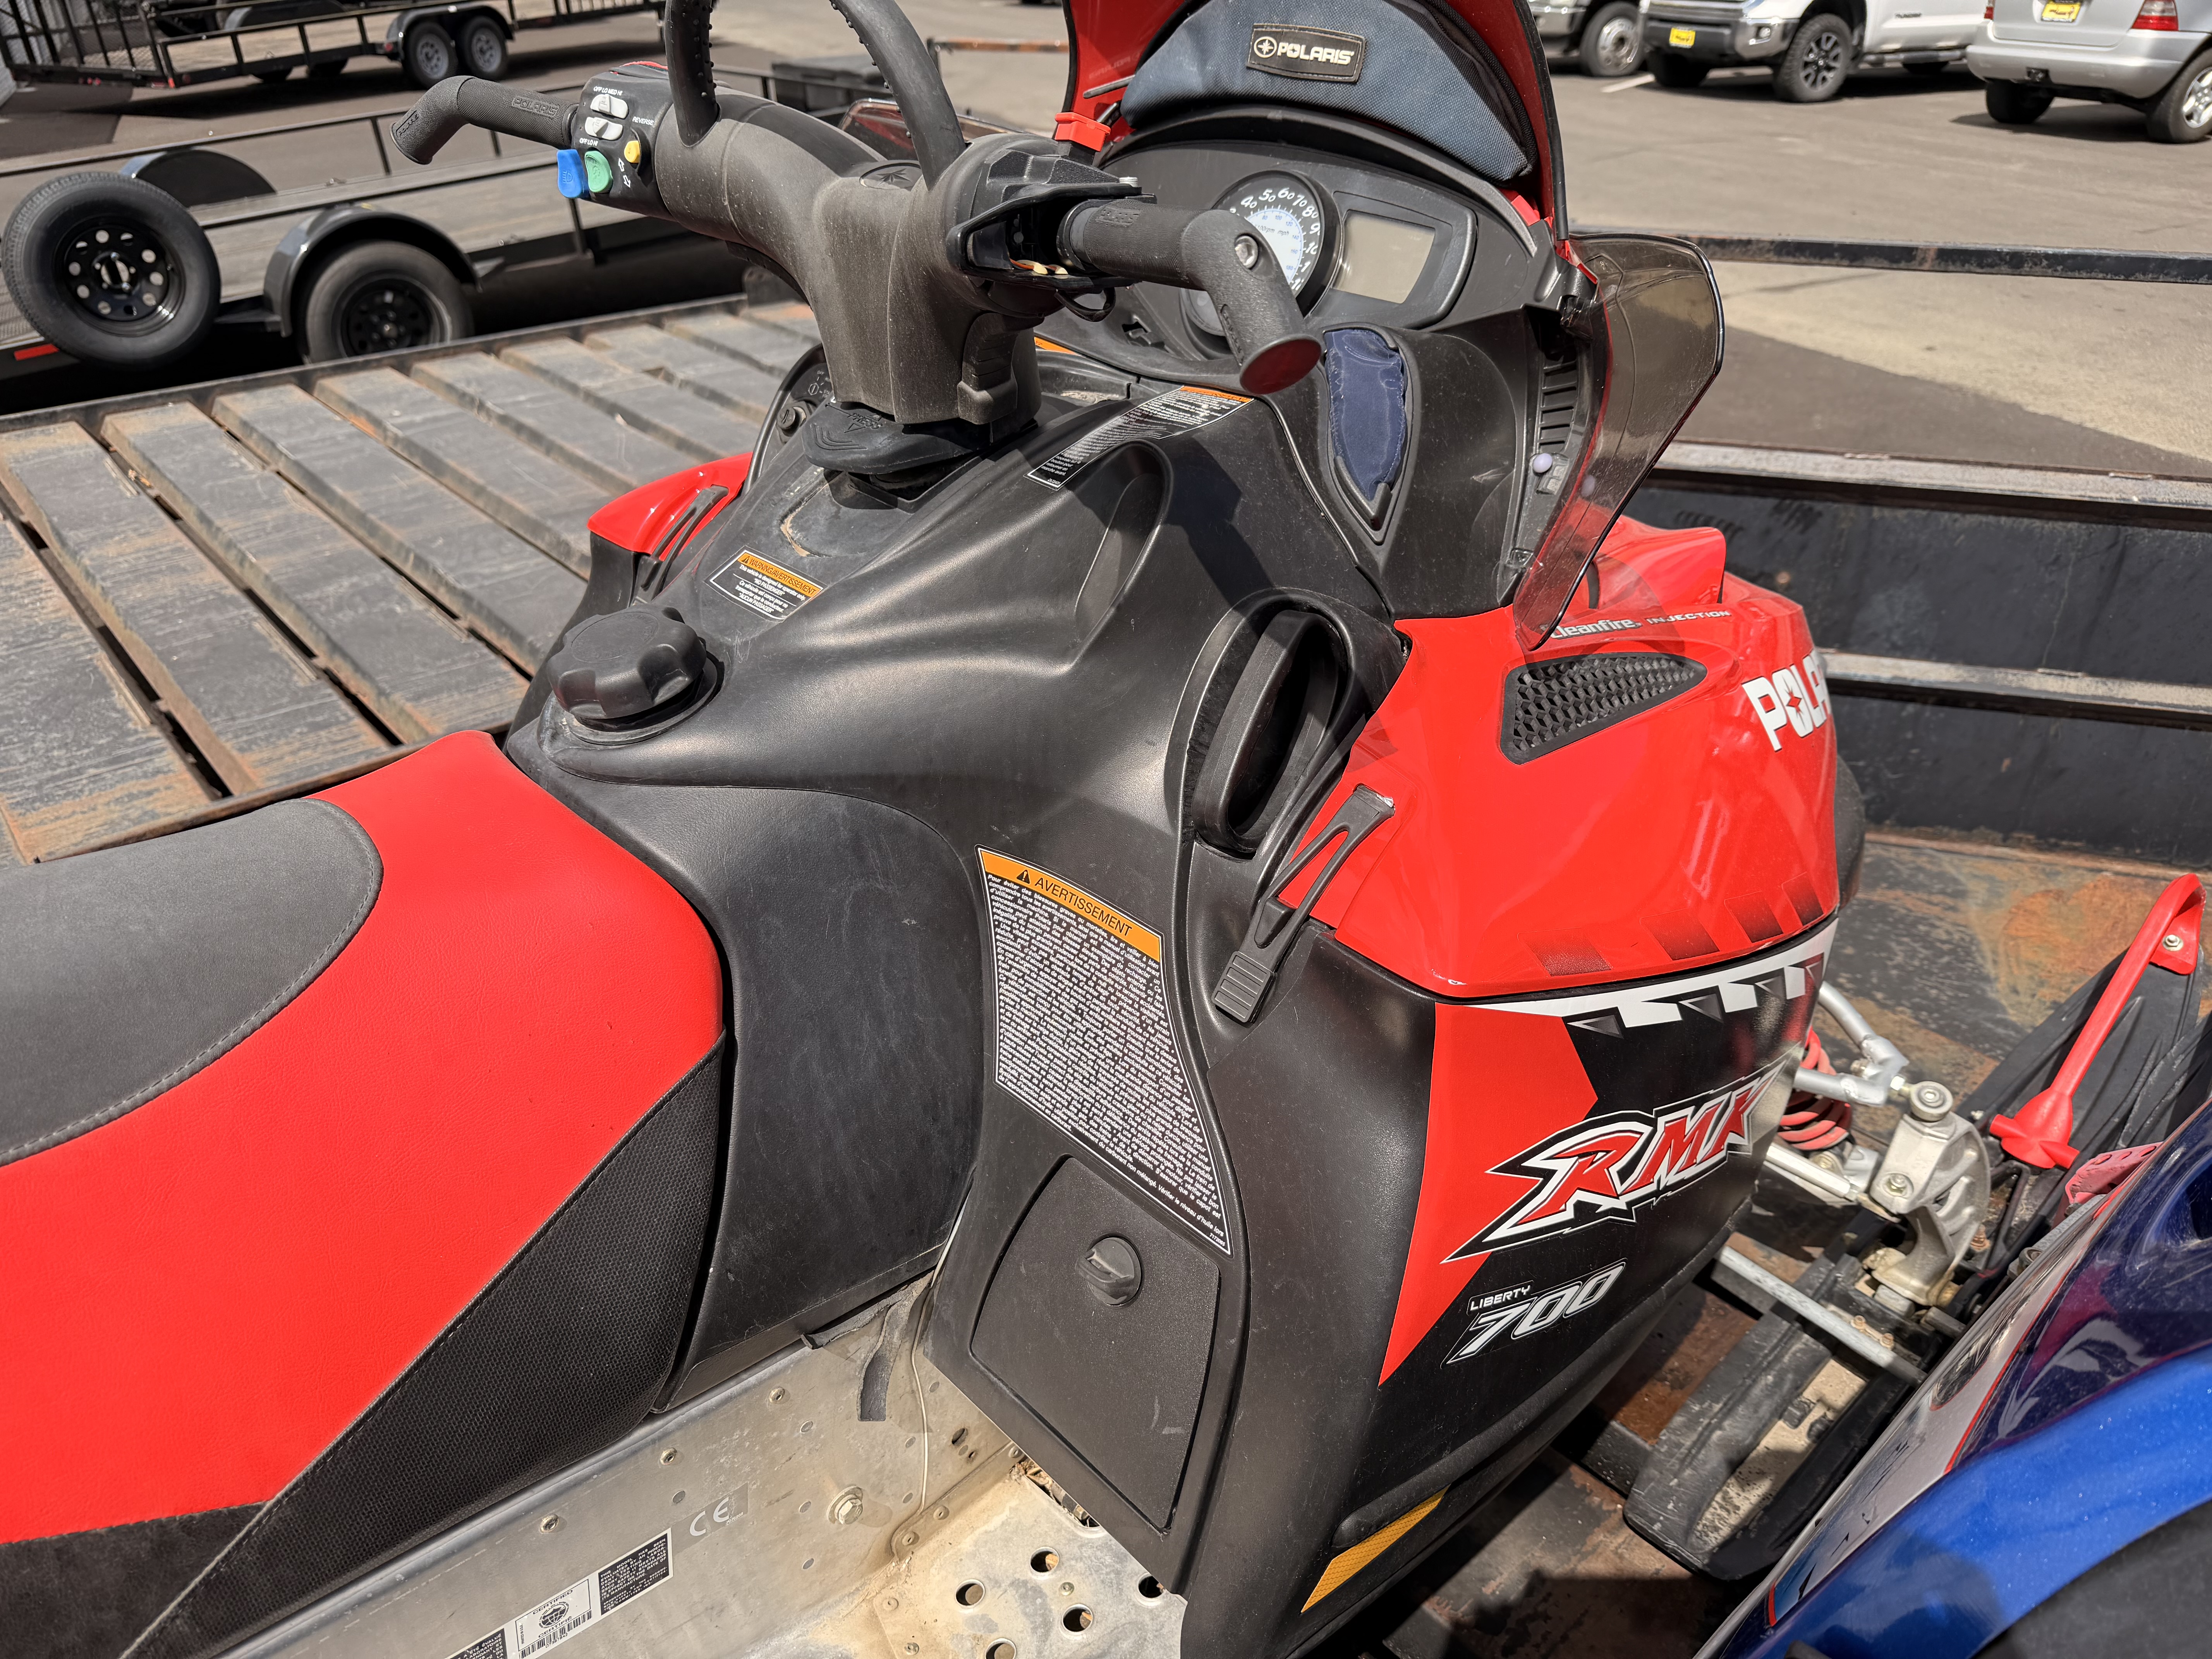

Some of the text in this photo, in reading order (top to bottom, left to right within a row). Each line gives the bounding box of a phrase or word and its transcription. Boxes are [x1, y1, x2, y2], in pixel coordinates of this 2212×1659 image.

[1278, 41, 1354, 65] POLARIS
[632, 116, 654, 126] REVERSE
[1240, 195, 1258, 209] 40
[1259, 188, 1276, 202] 50
[1277, 187, 1295, 200] 60
[1292, 194, 1308, 207] 70
[1302, 206, 1319, 218] 80
[747, 568, 759, 577] vehicle
[761, 576, 779, 586] designed
[782, 586, 798, 596] operator
[749, 559, 816, 595] WARNING/AVERTISSEMENT
[1647, 610, 1731, 625] INJECTION
[1741, 646, 1832, 752] POLA
[1035, 876, 1132, 936] AVERTISSEMENT
[988, 874, 1001, 883] Pour
[1003, 880, 1019, 890] éviter
[1034, 893, 1058, 908] blessures
[1059, 907, 1076, 919] graves
[1085, 922, 1108, 939] mortelles,
[1109, 935, 1118, 944] lire
[1127, 946, 1141, 958] veiller
[1147, 958, 1159, 969] bien
[989, 882, 1020, 897] comprendre
[1021, 893, 1033, 903] tous
[1041, 904, 1077, 927] avertissements,
[1077, 924, 1089, 933] ainsi
[1103, 939, 1120, 953] manuel
[1146, 966, 1159, 977] avant
[1026, 903, 1049, 918] machine.
[1069, 926, 1087, 939] manuel
[1100, 945, 1124, 963] manquant,
[1128, 962, 1151, 978] contacter
[1051, 1113, 1071, 1131] carburant.
[998, 1067, 1017, 1083] Système
[1054, 1108, 1068, 1120] utiliser
[1068, 1119, 1099, 1143] exclusivement
[1105, 1146, 1127, 1165] carburant
[1127, 1162, 1136, 1172] non
[1136, 1170, 1157, 1187] mélangé.
[1158, 1185, 1175, 1200] Vérifier
[1180, 1202, 1196, 1217] niveau
[1213, 1226, 1224, 1237] lors
[1482, 1060, 1786, 1242] RMK
[1447, 1261, 1626, 1363] 700
[1470, 1285, 1532, 1312] LIBERTY
[601, 1576, 614, 1585] DENT
[620, 1560, 642, 1574] TESTING
[601, 1578, 617, 1589] ATORY
[620, 1570, 630, 1578] AND
[639, 1556, 654, 1567] MEETS
[601, 1565, 628, 1582] EVALUATED
[617, 1558, 633, 1568] MODEL
[617, 1571, 636, 1583] SAFETY
[639, 1553, 666, 1571] STANDARDS
[608, 1580, 626, 1593] EFFECT
[647, 1561, 658, 1570] DATE
[533, 1590, 573, 1615] CERTIFIED
